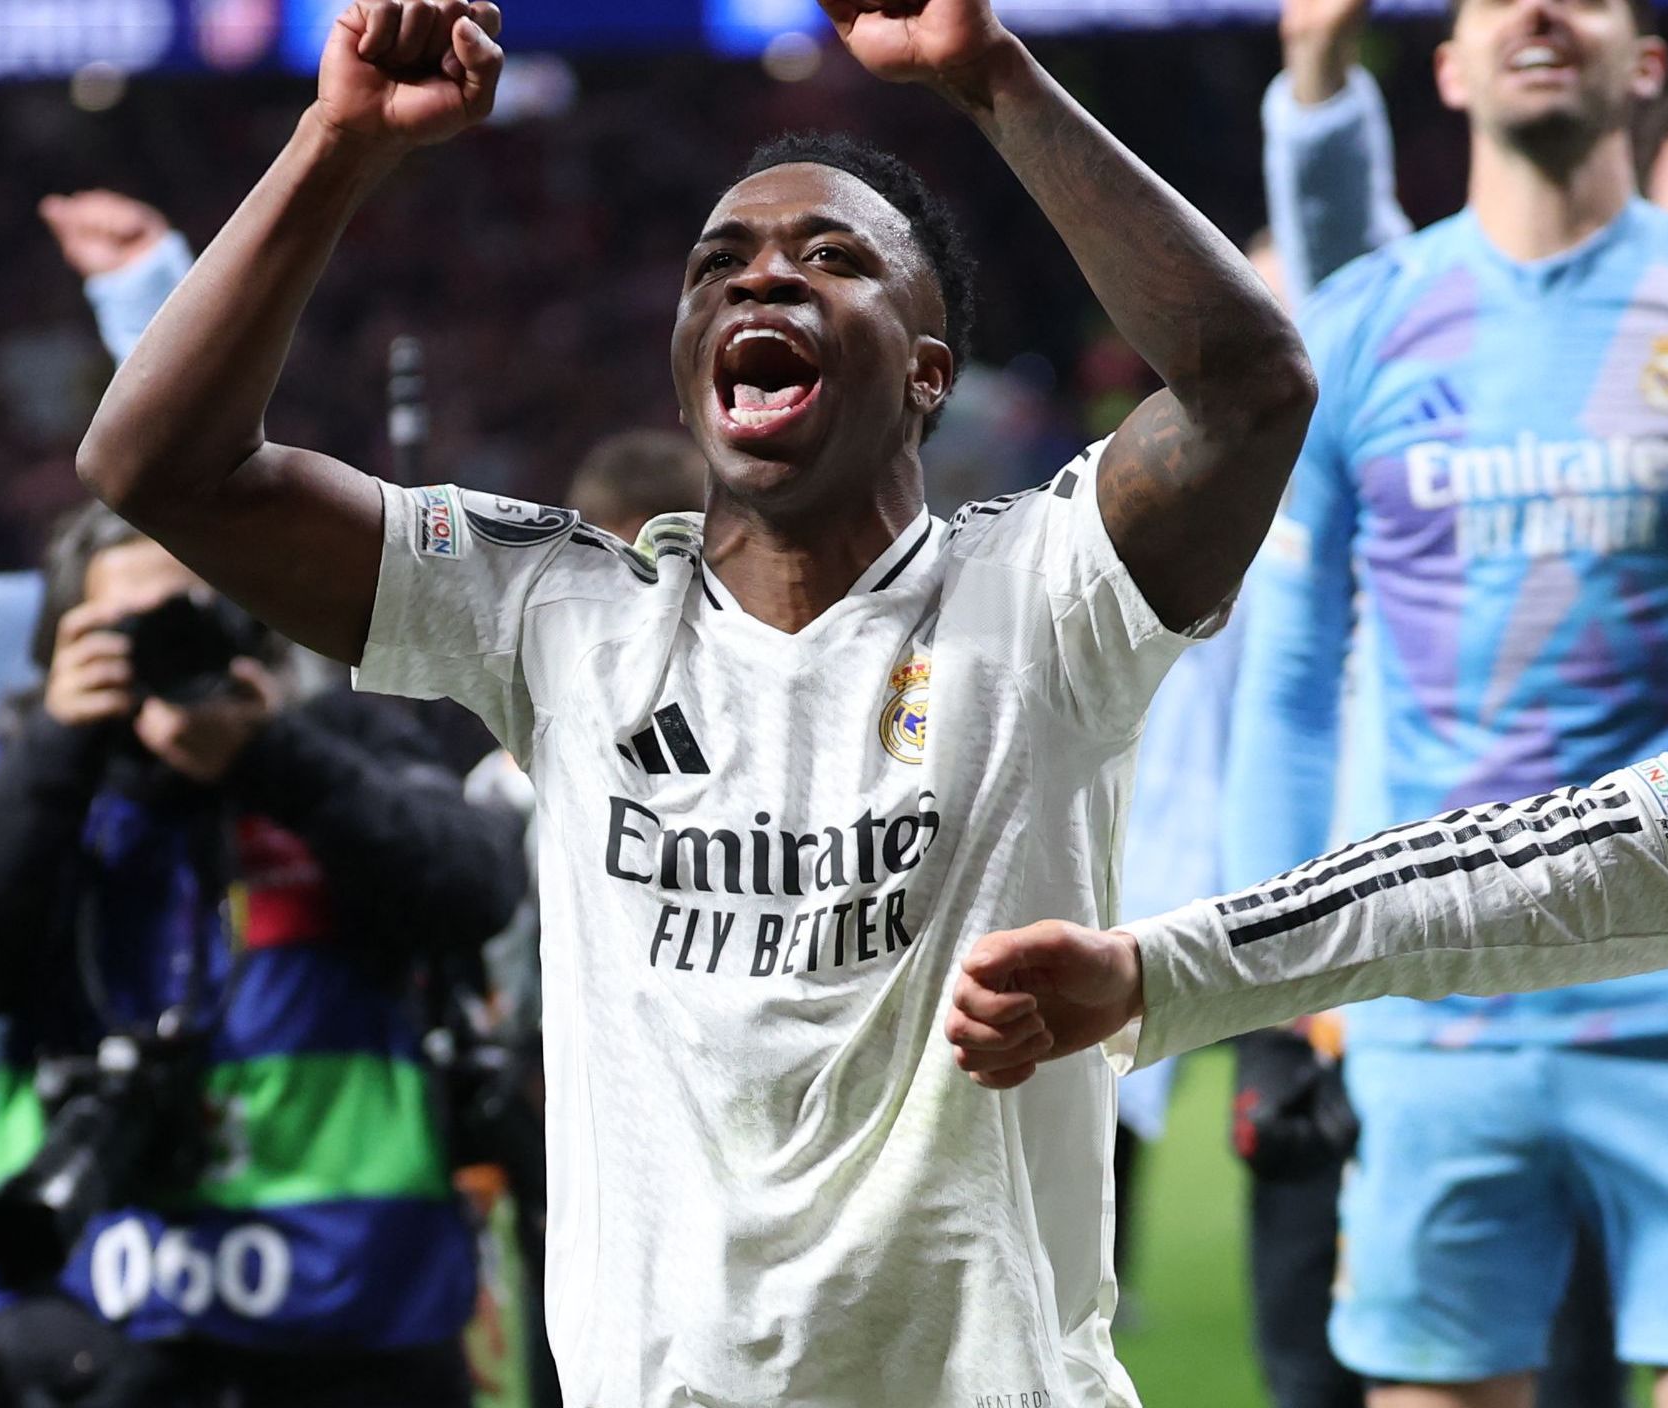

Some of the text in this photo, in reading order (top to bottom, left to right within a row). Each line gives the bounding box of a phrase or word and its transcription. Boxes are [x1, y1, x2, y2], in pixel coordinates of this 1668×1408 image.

[426, 485, 451, 554] DATION
[649, 888, 913, 977] FLY BETTER
[90, 1217, 292, 1321] 060
